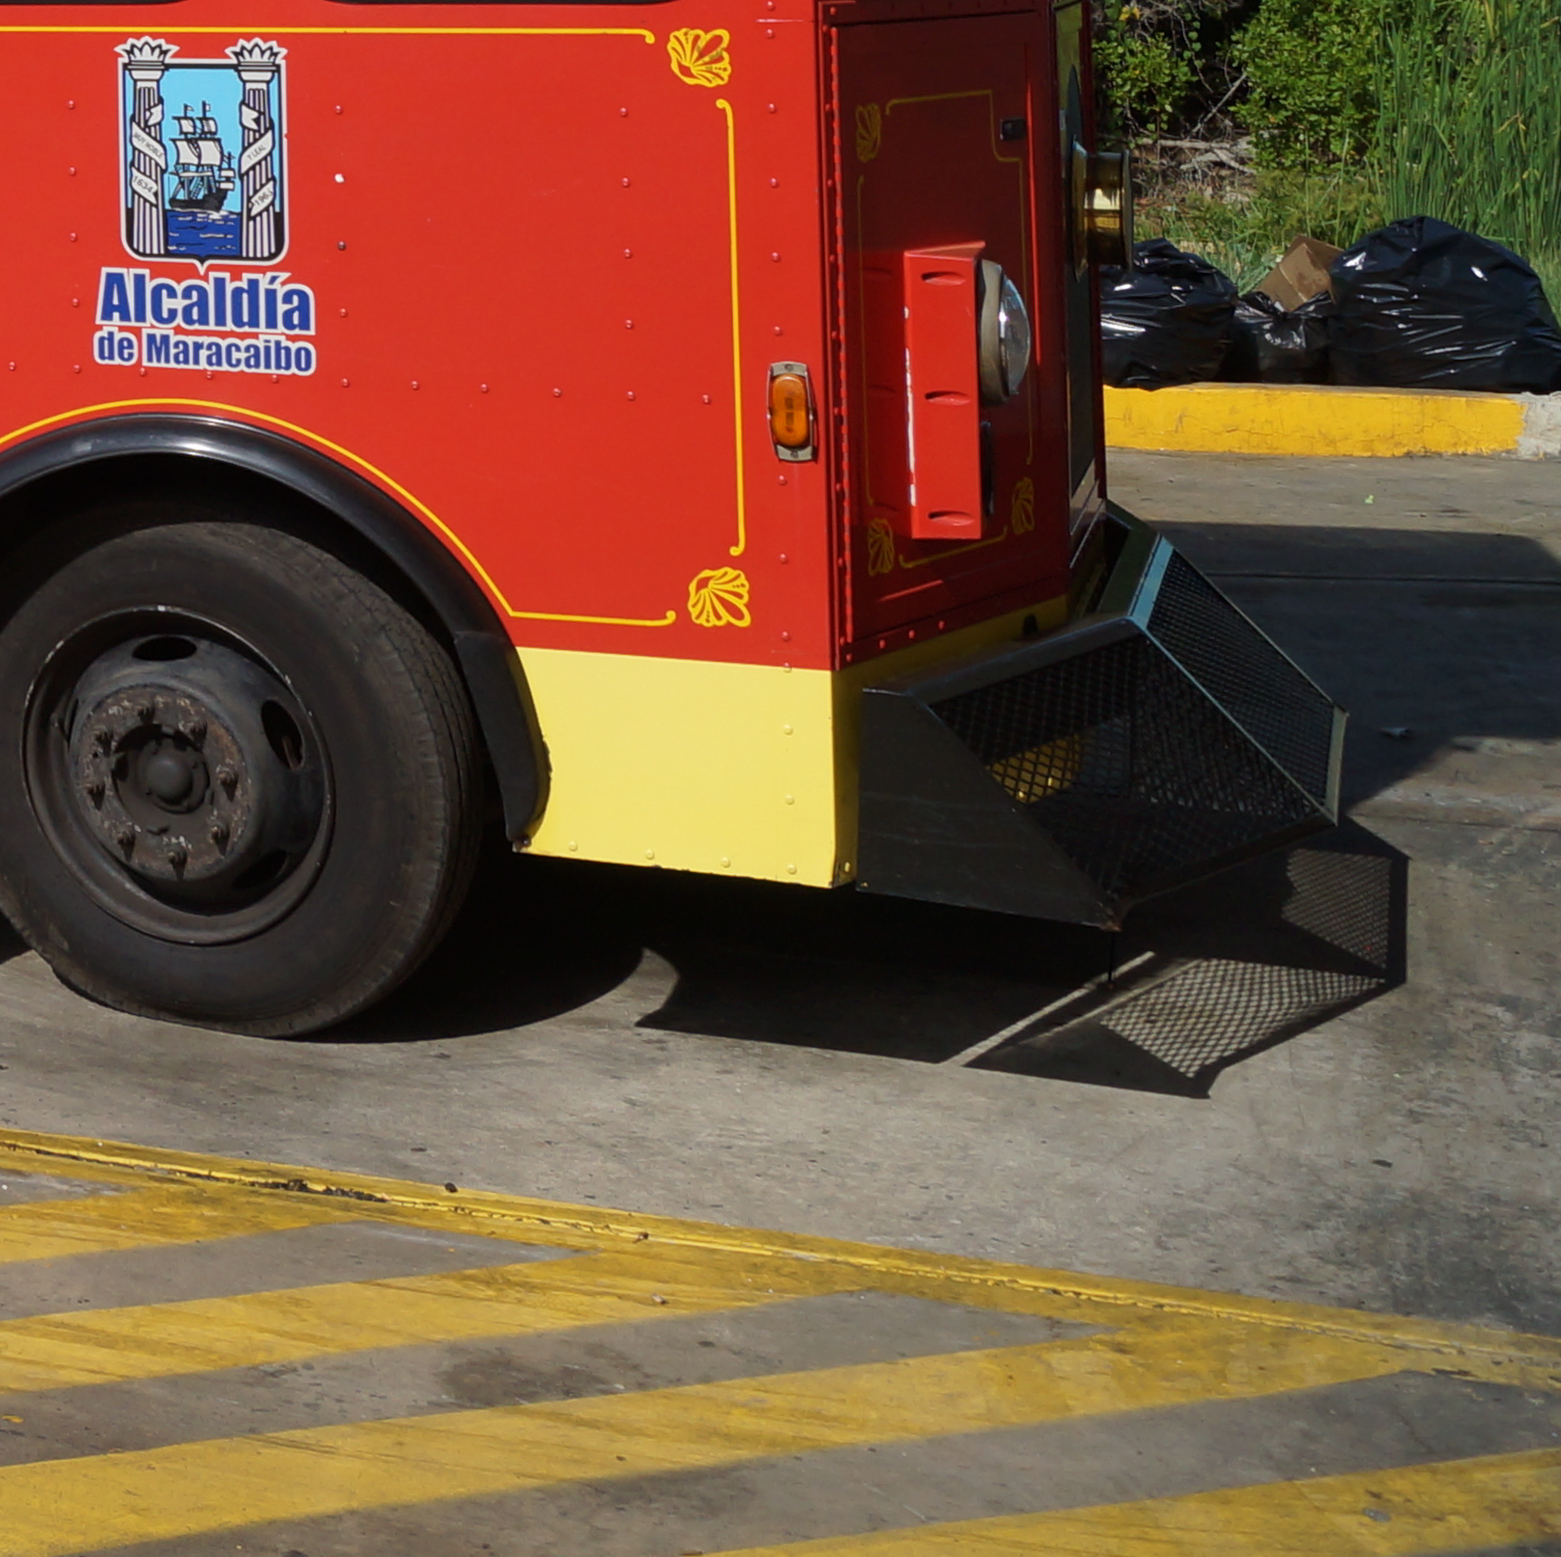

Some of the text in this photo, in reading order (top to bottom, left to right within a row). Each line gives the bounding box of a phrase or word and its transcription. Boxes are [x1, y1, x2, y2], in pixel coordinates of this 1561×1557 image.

[146, 141, 164, 159] NOBLE
[134, 176, 154, 193] 1634
[99, 271, 312, 332] Alcaldía
[97, 330, 313, 373] de Maracaibo
